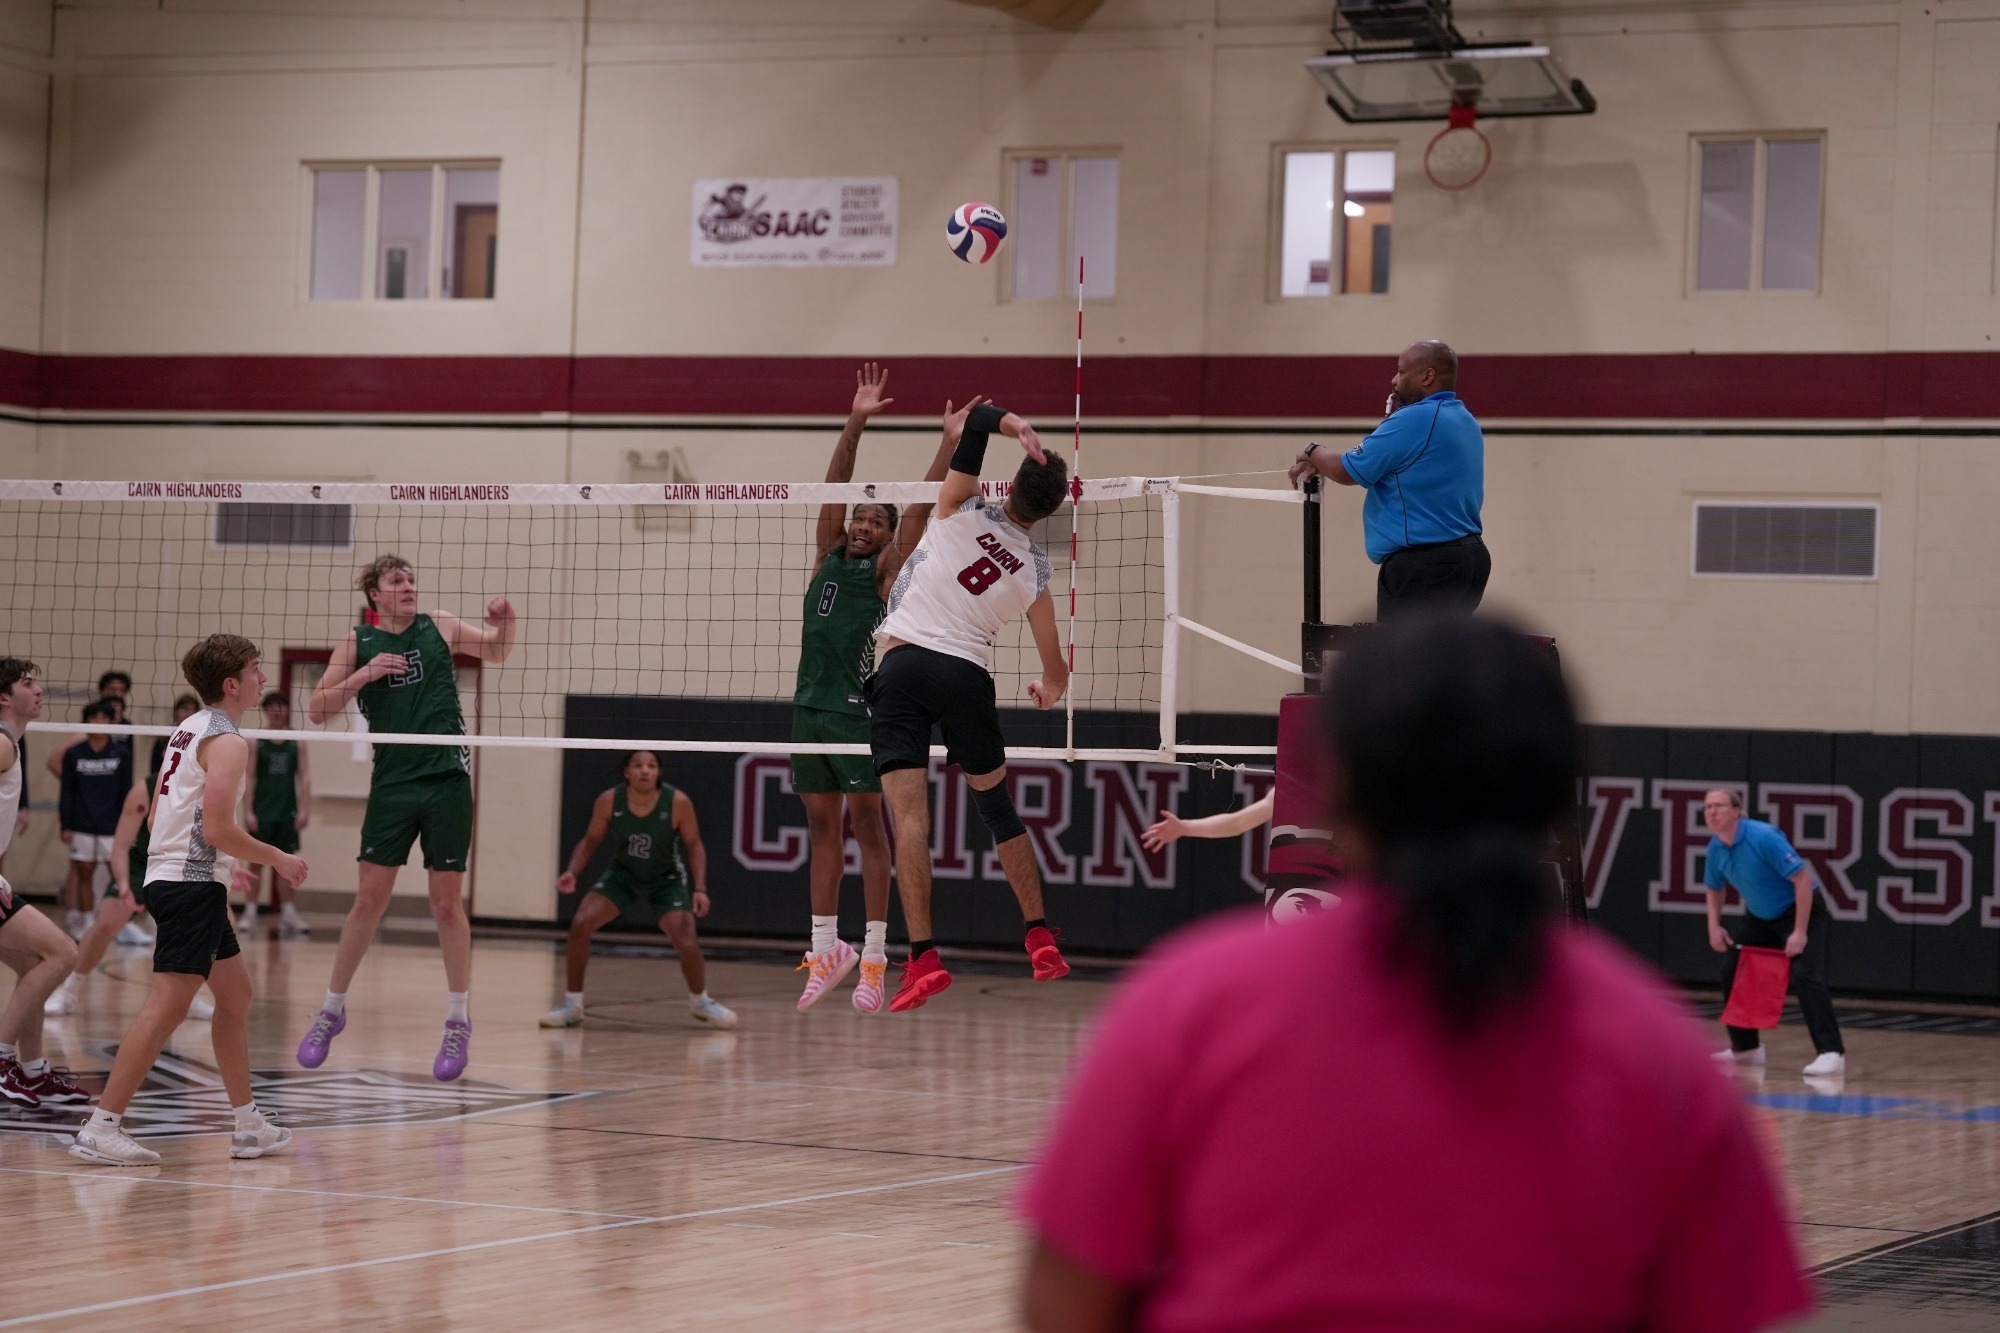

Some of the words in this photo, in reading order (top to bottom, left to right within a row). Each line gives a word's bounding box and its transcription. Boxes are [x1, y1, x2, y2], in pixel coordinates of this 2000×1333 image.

[752, 209, 831, 237] SAAC
[128, 482, 161, 497] CAIRN
[166, 482, 242, 498] HIGHLANDERS
[390, 485, 425, 500] CAIRN
[429, 485, 509, 500] HIGHLANDERS
[664, 484, 700, 500] CAIRN
[705, 484, 789, 500] HIGHLANDERS
[976, 532, 1025, 575] CAIRN
[957, 556, 1002, 596] 8
[818, 581, 838, 617] 8
[170, 729, 197, 751] CAIRN
[160, 750, 182, 796] 2
[627, 833, 652, 859] 12
